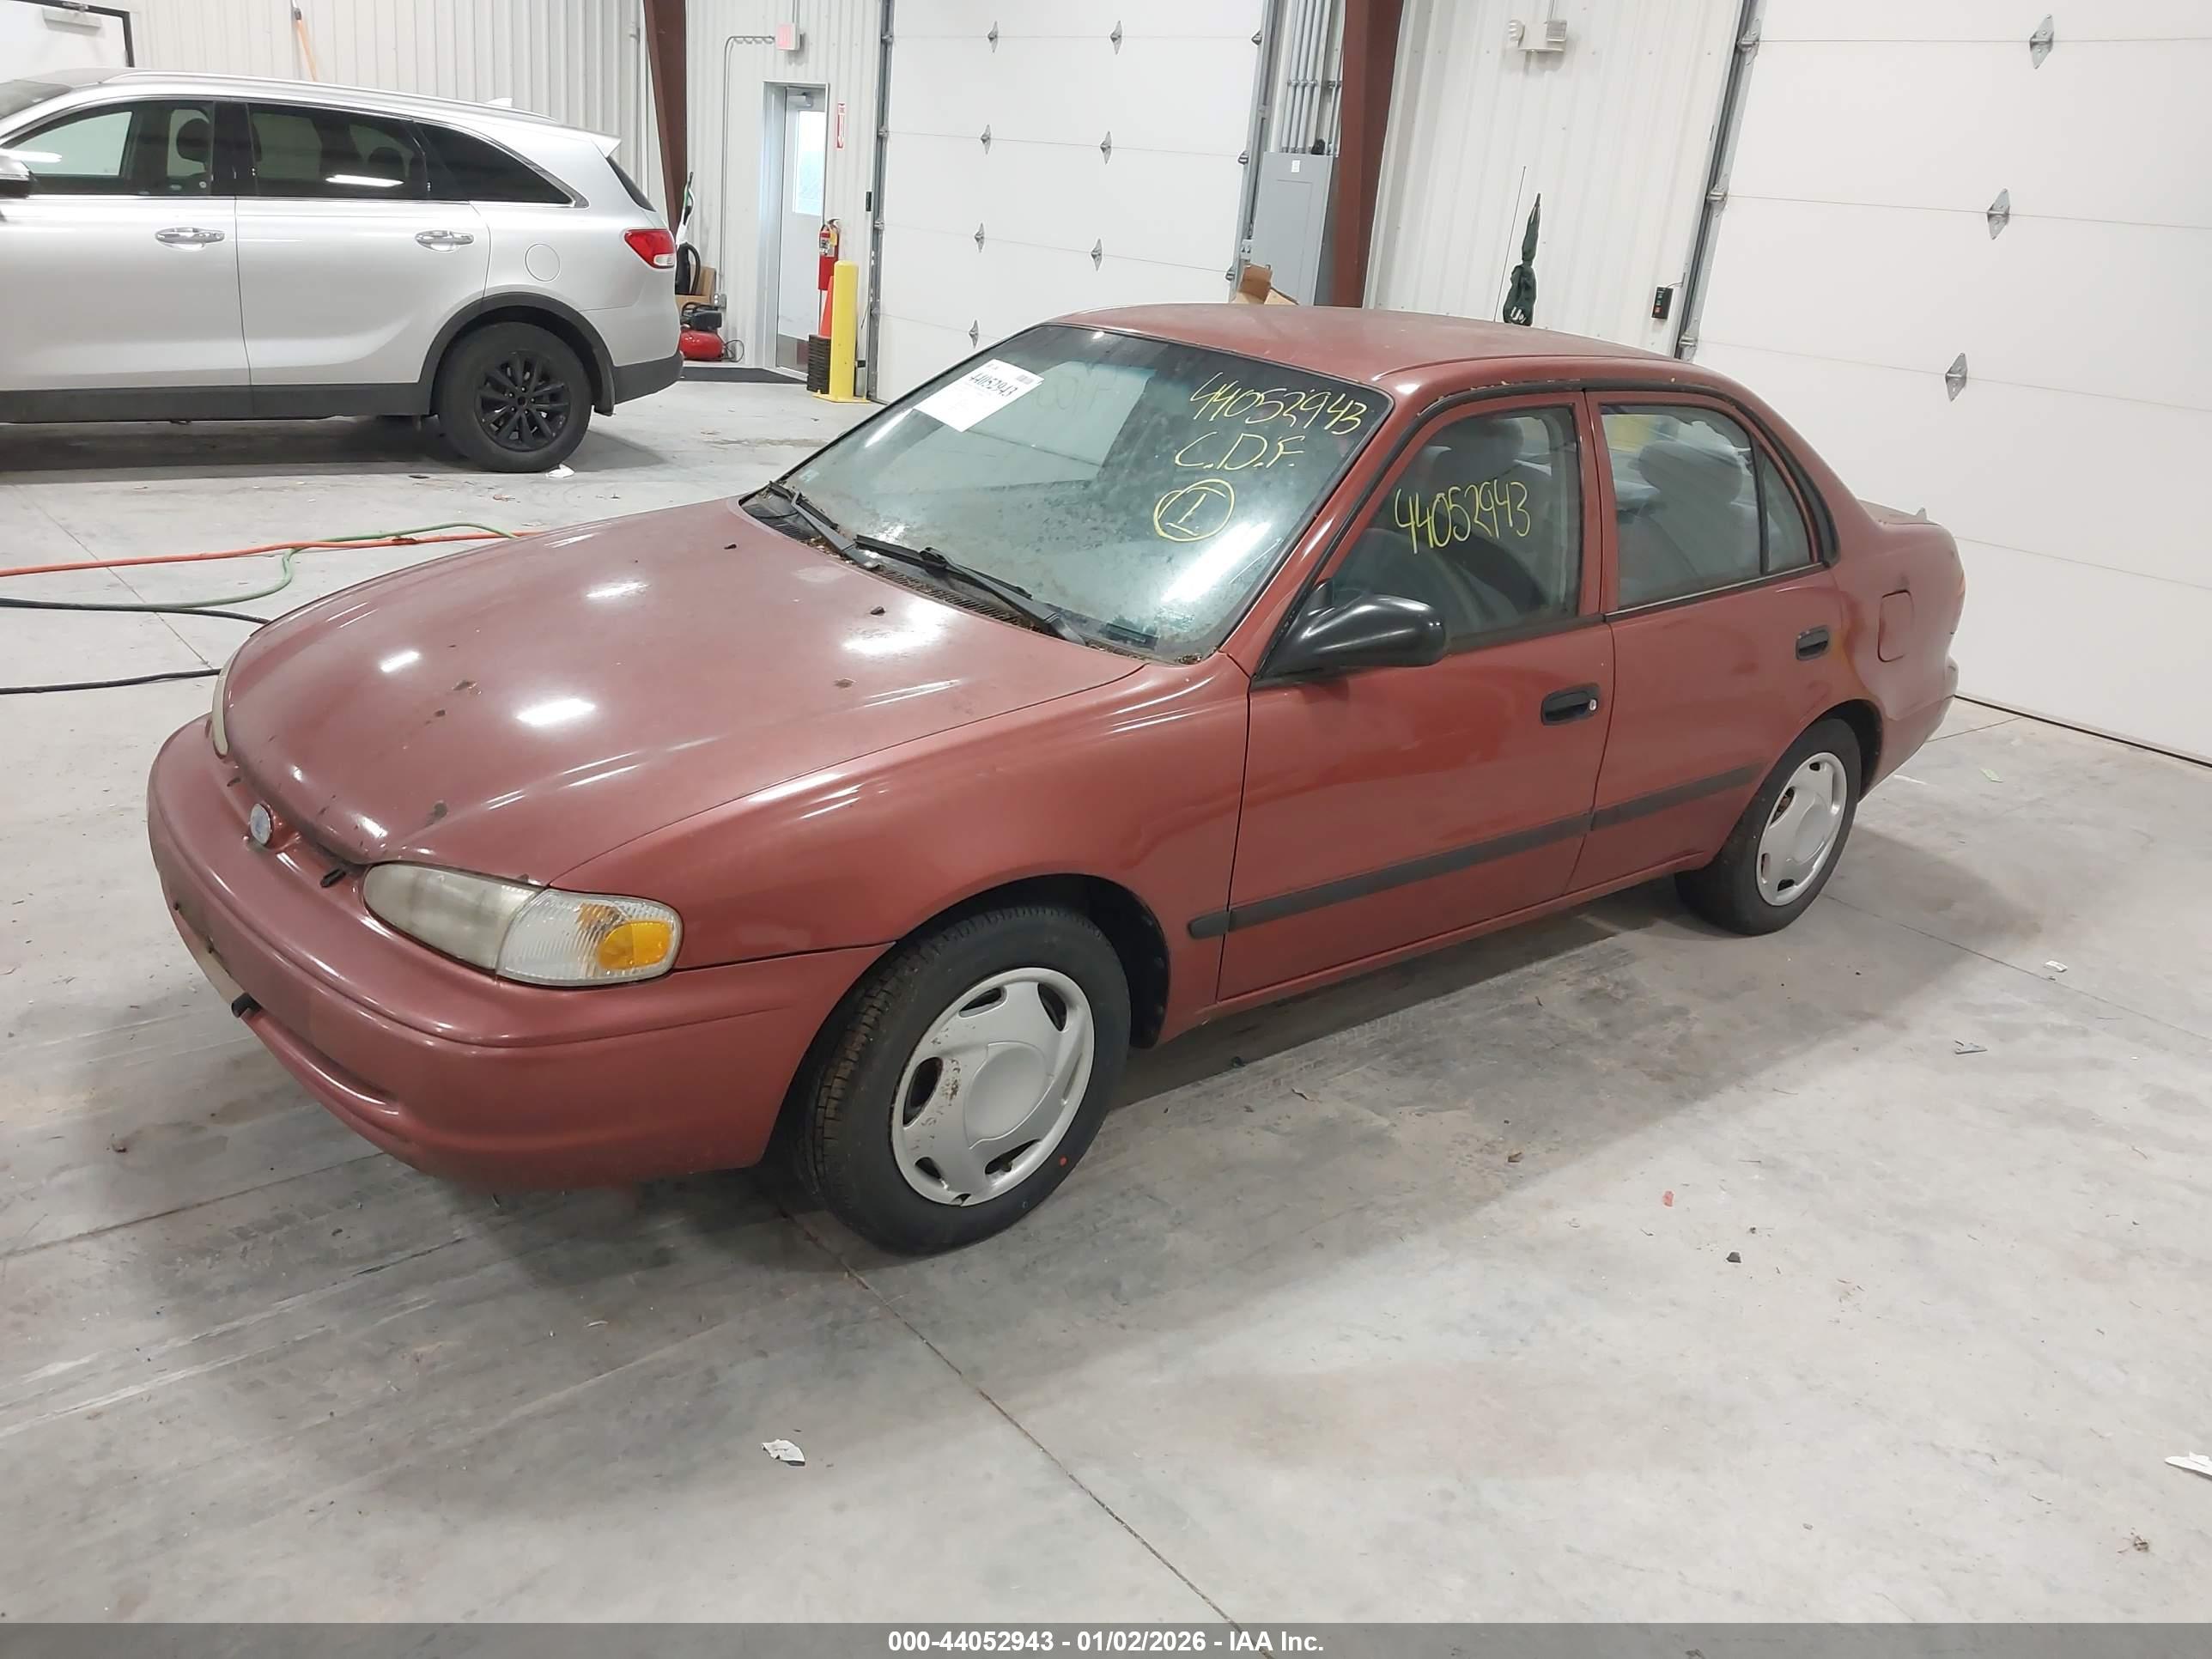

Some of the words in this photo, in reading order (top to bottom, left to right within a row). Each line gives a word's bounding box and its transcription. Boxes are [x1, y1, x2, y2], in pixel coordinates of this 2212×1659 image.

[969, 372, 1019, 398] 44052943
[1189, 371, 1368, 435] 44052943
[1394, 478, 1531, 555] 44052943
